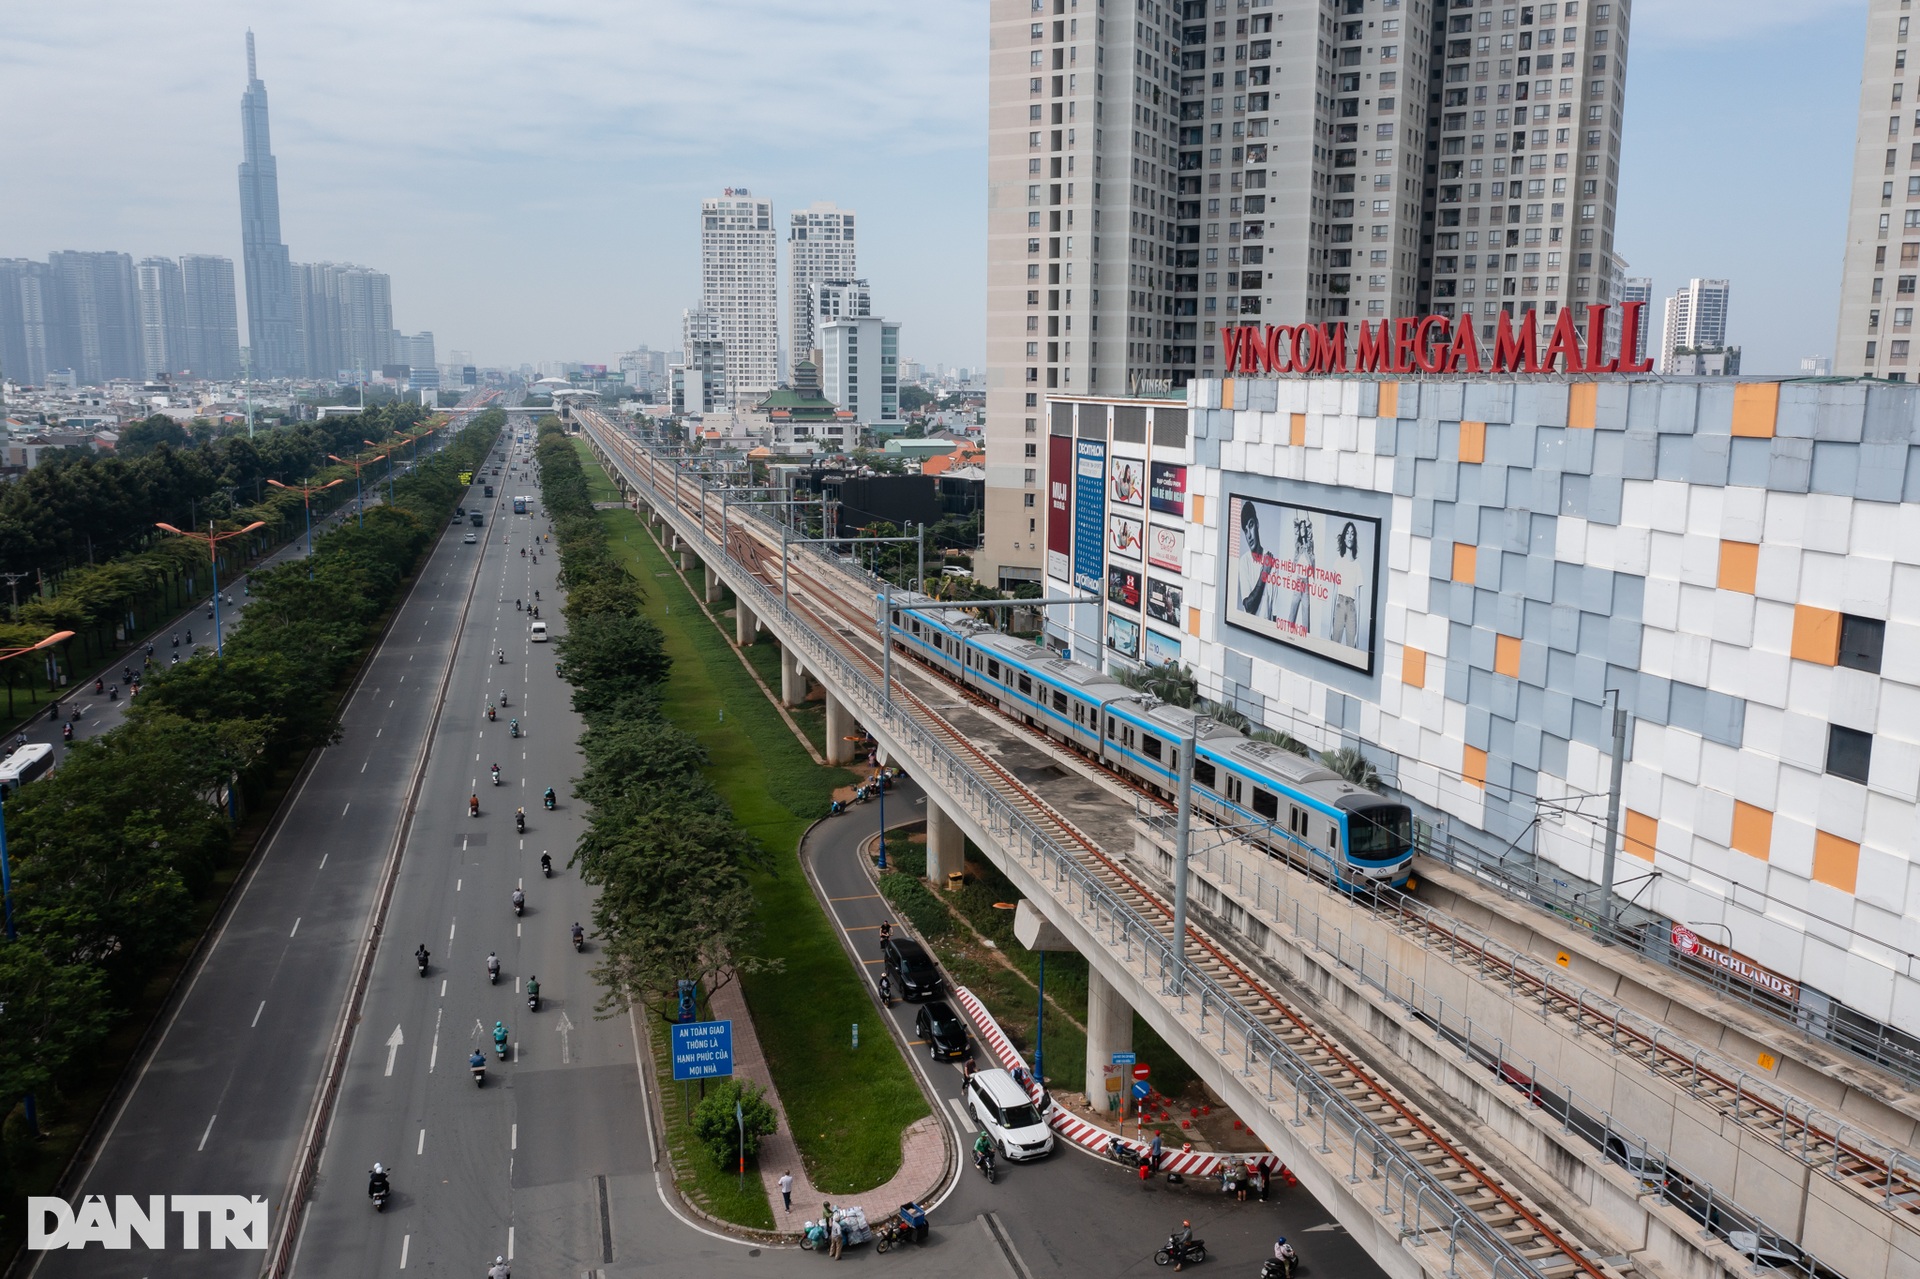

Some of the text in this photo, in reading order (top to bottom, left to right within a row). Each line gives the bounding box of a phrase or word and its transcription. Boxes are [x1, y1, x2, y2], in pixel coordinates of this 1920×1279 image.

[735, 188, 748, 196] MB
[1220, 301, 1655, 374] VINCOM MEGA MALL
[1078, 442, 1104, 457] DECATHLON
[1052, 481, 1067, 501] MUJI
[1316, 568, 1342, 585] TRANG
[1318, 584, 1328, 600] ÚC
[1702, 945, 1792, 997] HIGHLANDS
[680, 1025, 724, 1037] AN TOÀN GIAO
[686, 1037, 718, 1049] THÔNG LÀ
[677, 1049, 729, 1064] HẠNH PHÚC CỦA
[689, 1063, 717, 1075] MỌI NHÀ
